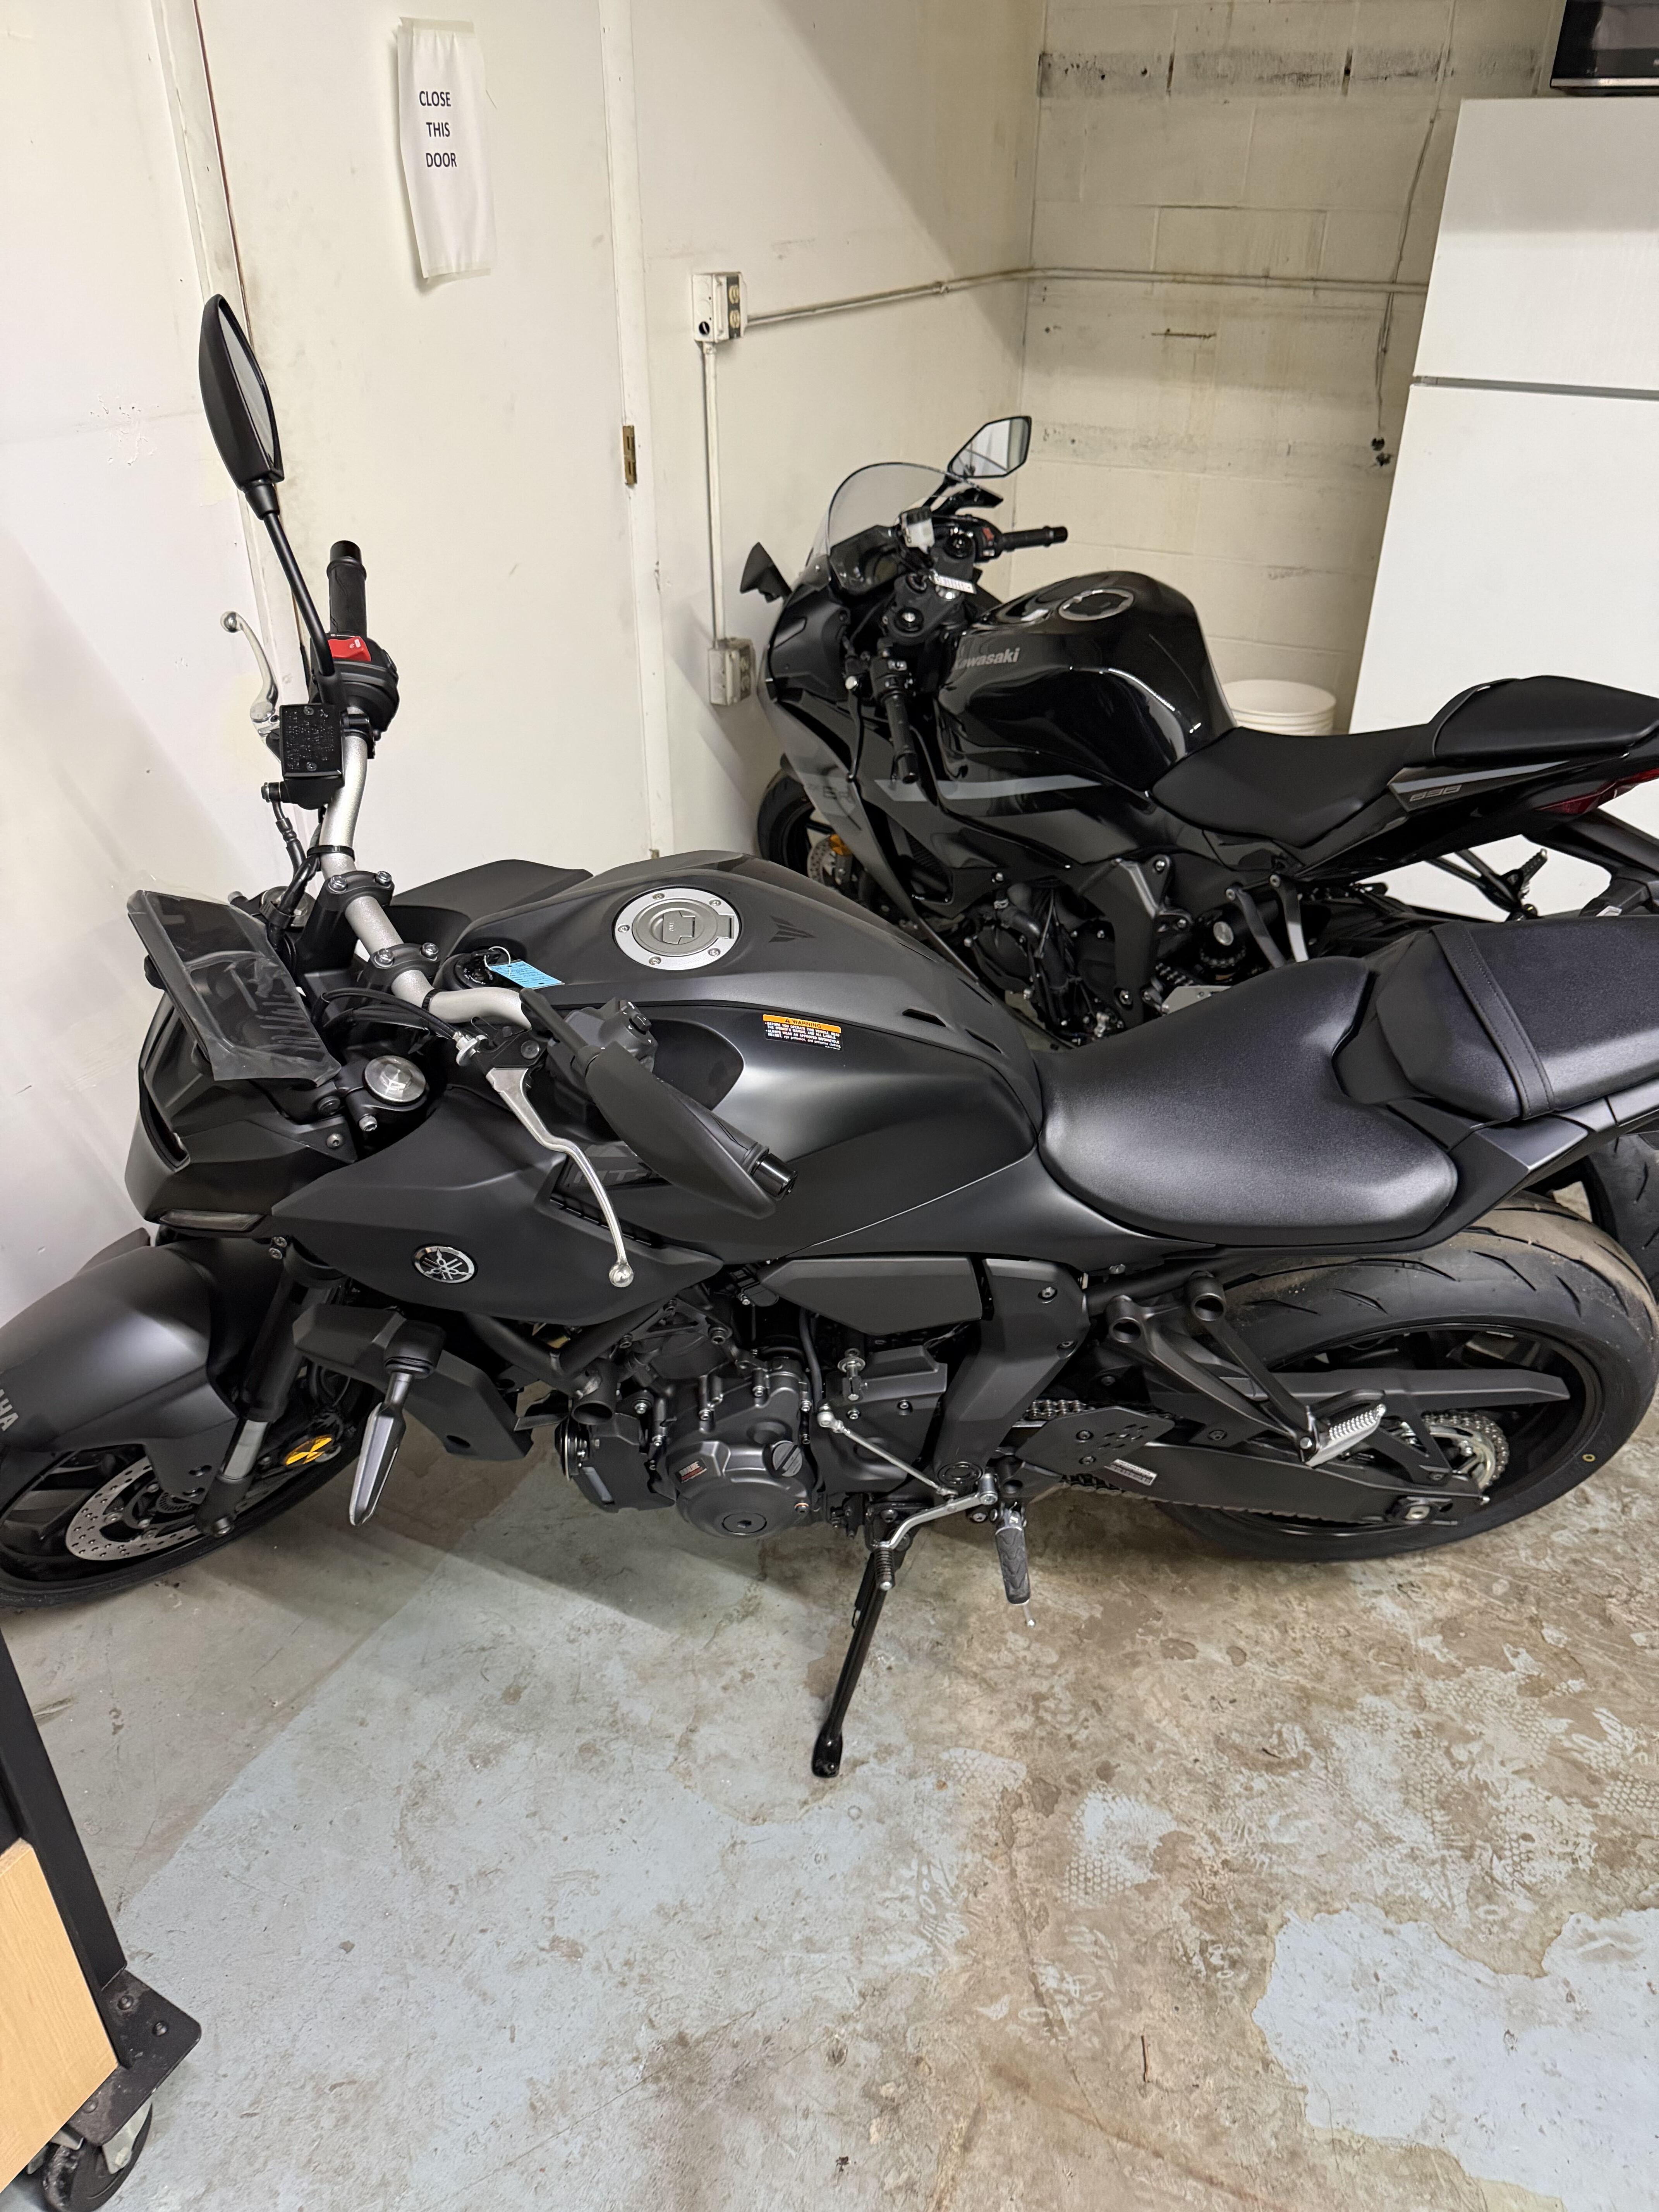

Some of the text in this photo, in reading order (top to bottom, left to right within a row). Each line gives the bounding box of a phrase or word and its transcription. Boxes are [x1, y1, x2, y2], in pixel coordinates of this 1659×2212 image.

[419, 91, 451, 106] CLOSE
[426, 122, 450, 137] THIS
[426, 153, 457, 167] DOOR
[792, 1019, 821, 1029] WARNING
